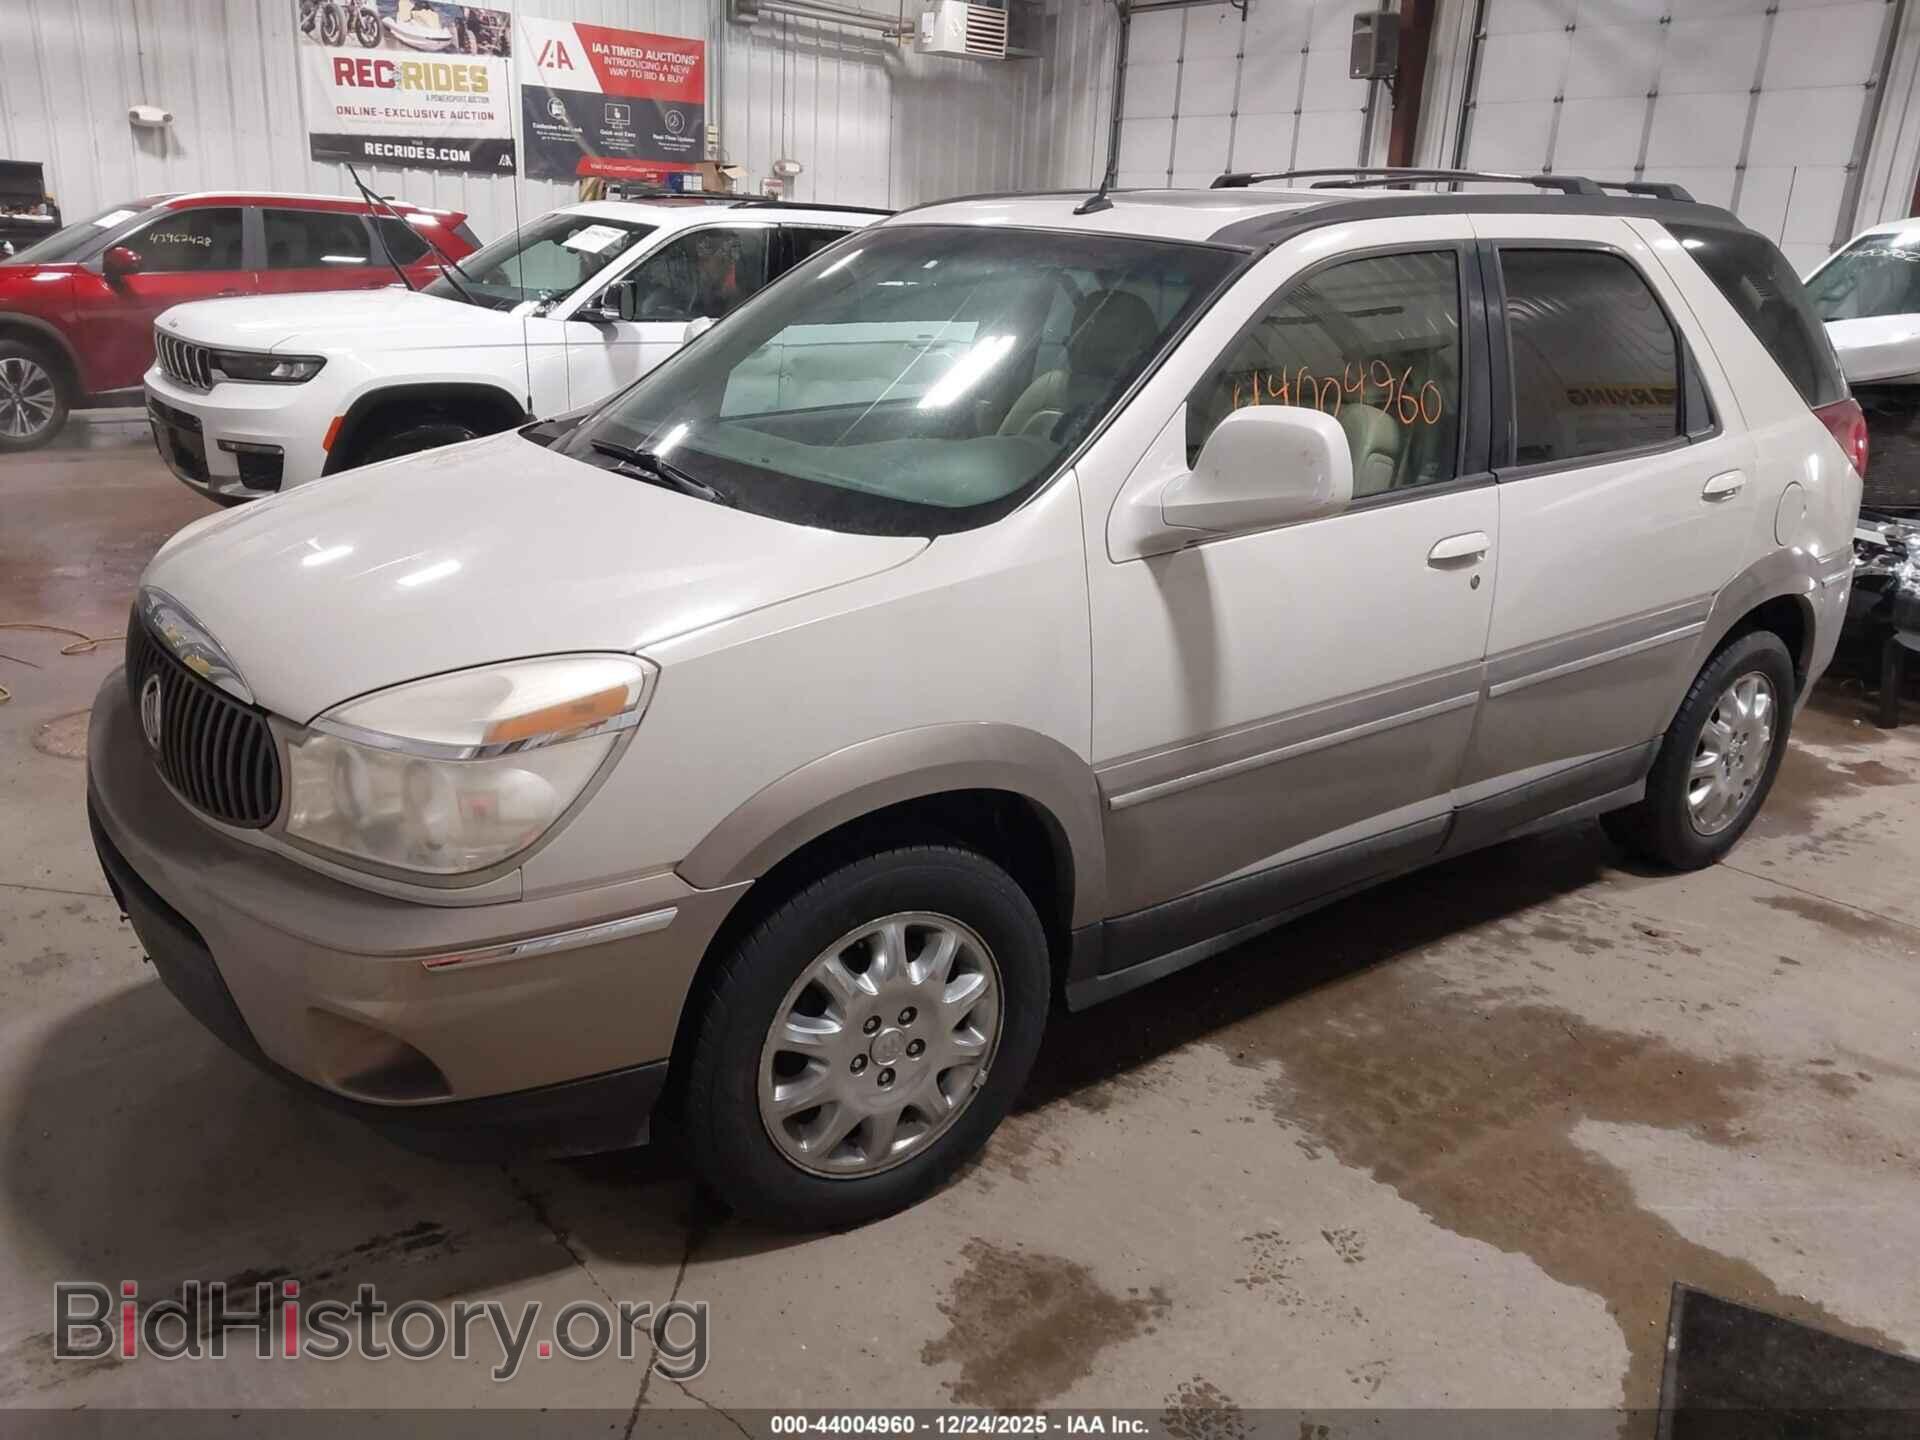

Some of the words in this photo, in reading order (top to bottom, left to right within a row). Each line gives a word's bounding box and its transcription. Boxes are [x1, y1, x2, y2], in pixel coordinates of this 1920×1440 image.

[592, 42, 609, 54] IAA
[610, 45, 643, 59] TIMED
[604, 56, 661, 72] INTRODUCING
[662, 63, 669, 72] A
[670, 65, 690, 75] NEW
[333, 57, 397, 89] REC
[401, 61, 489, 93] RIDES
[609, 67, 628, 77] WAY
[630, 69, 642, 79] TO
[643, 71, 657, 81] BID
[658, 73, 666, 83] &
[667, 74, 685, 83] BUY
[336, 105, 447, 121] ONLINE-EXCLUSIVE
[449, 110, 495, 121] AUCTION
[364, 142, 471, 162] RECRIDES.COM
